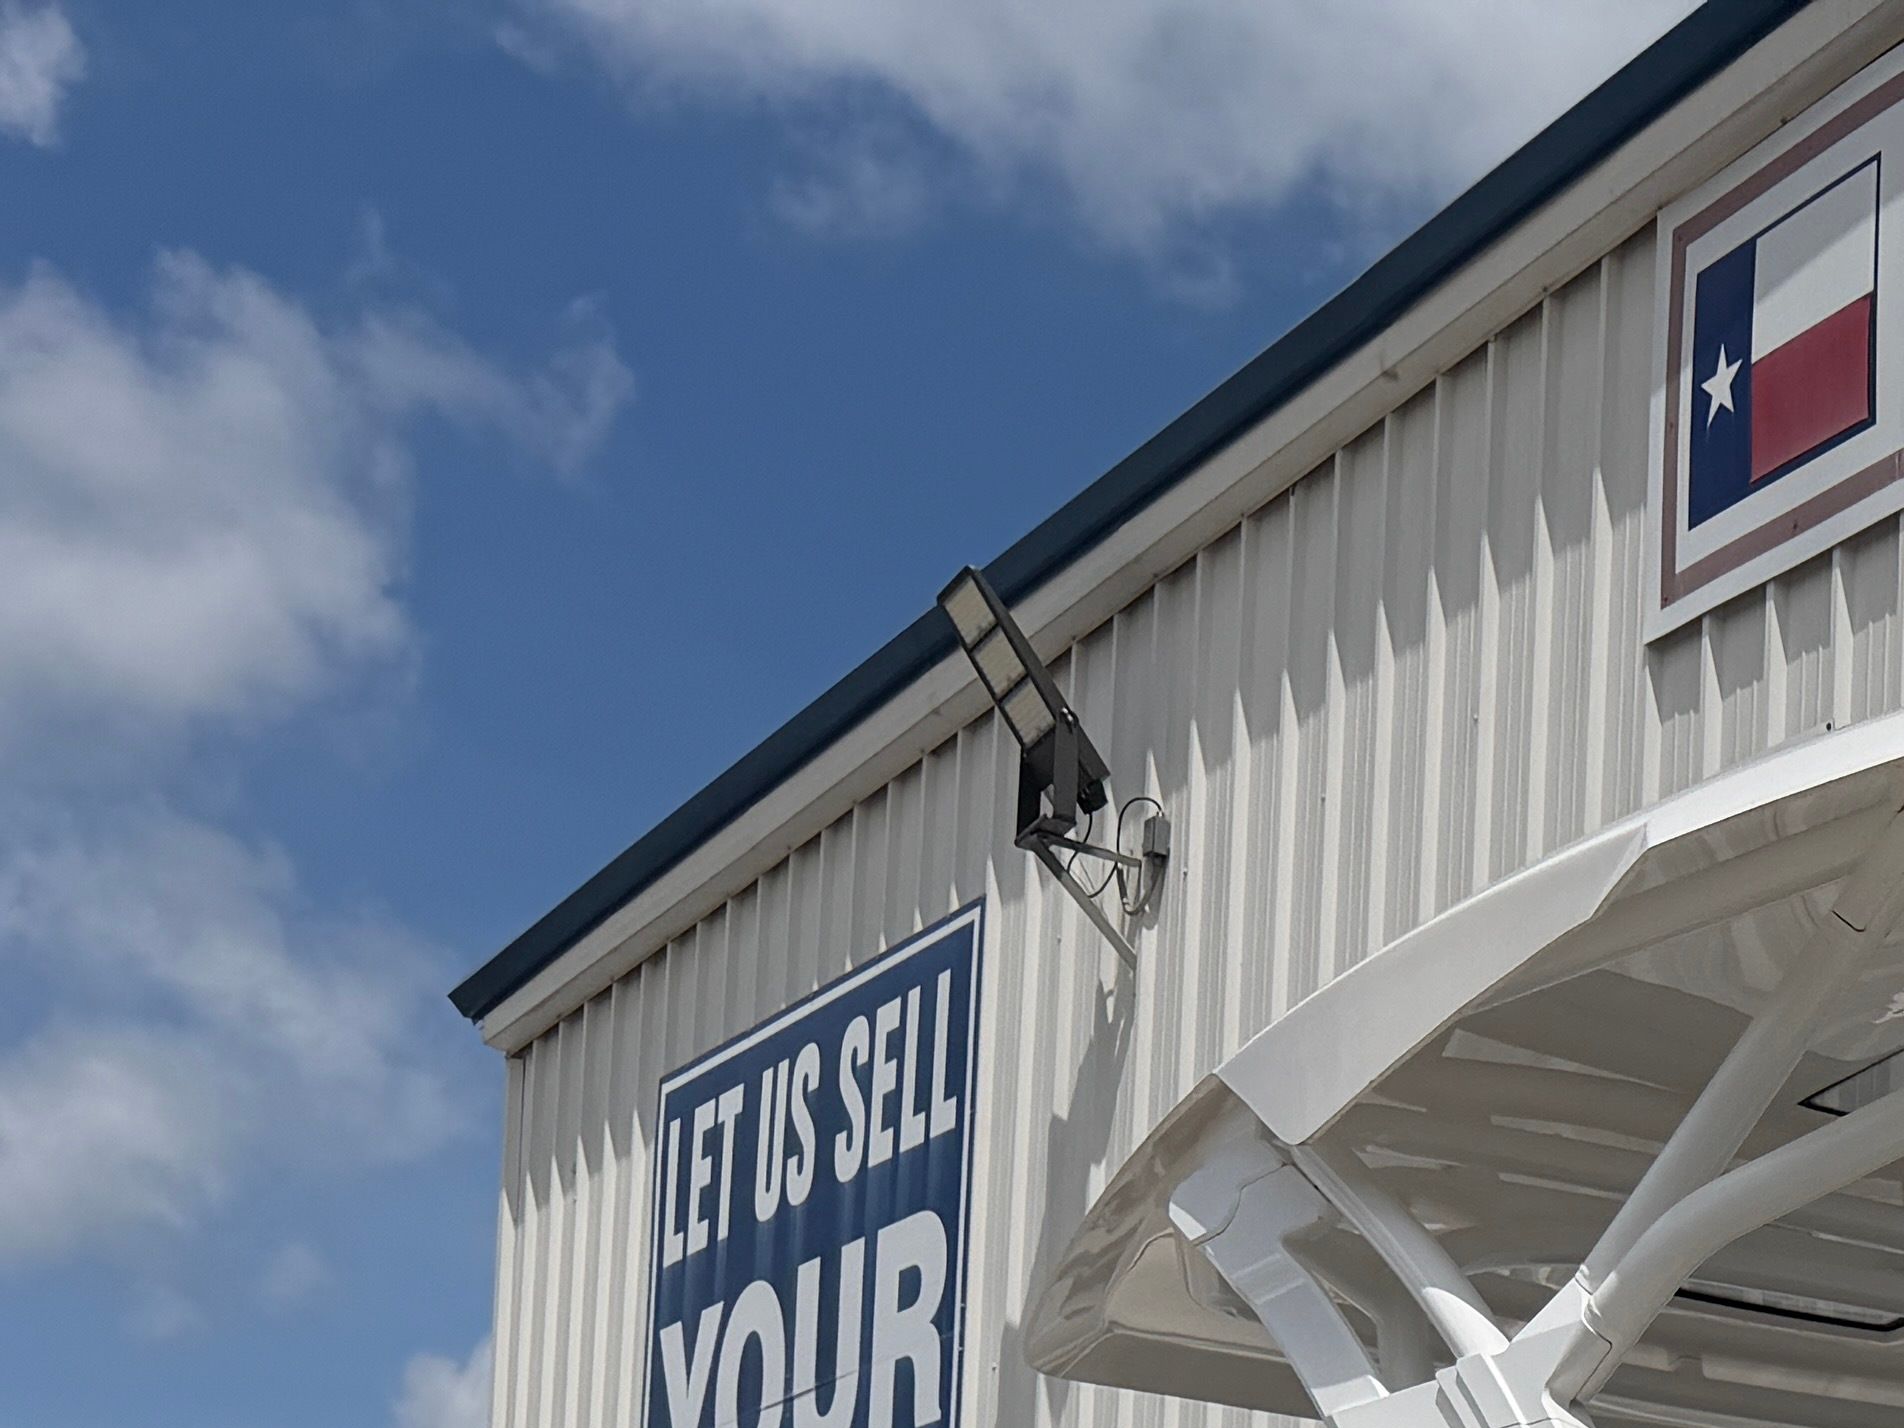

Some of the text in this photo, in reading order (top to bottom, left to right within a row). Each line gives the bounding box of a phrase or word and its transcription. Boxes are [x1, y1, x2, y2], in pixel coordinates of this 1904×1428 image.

[662, 967, 959, 1269] LET US SELL
